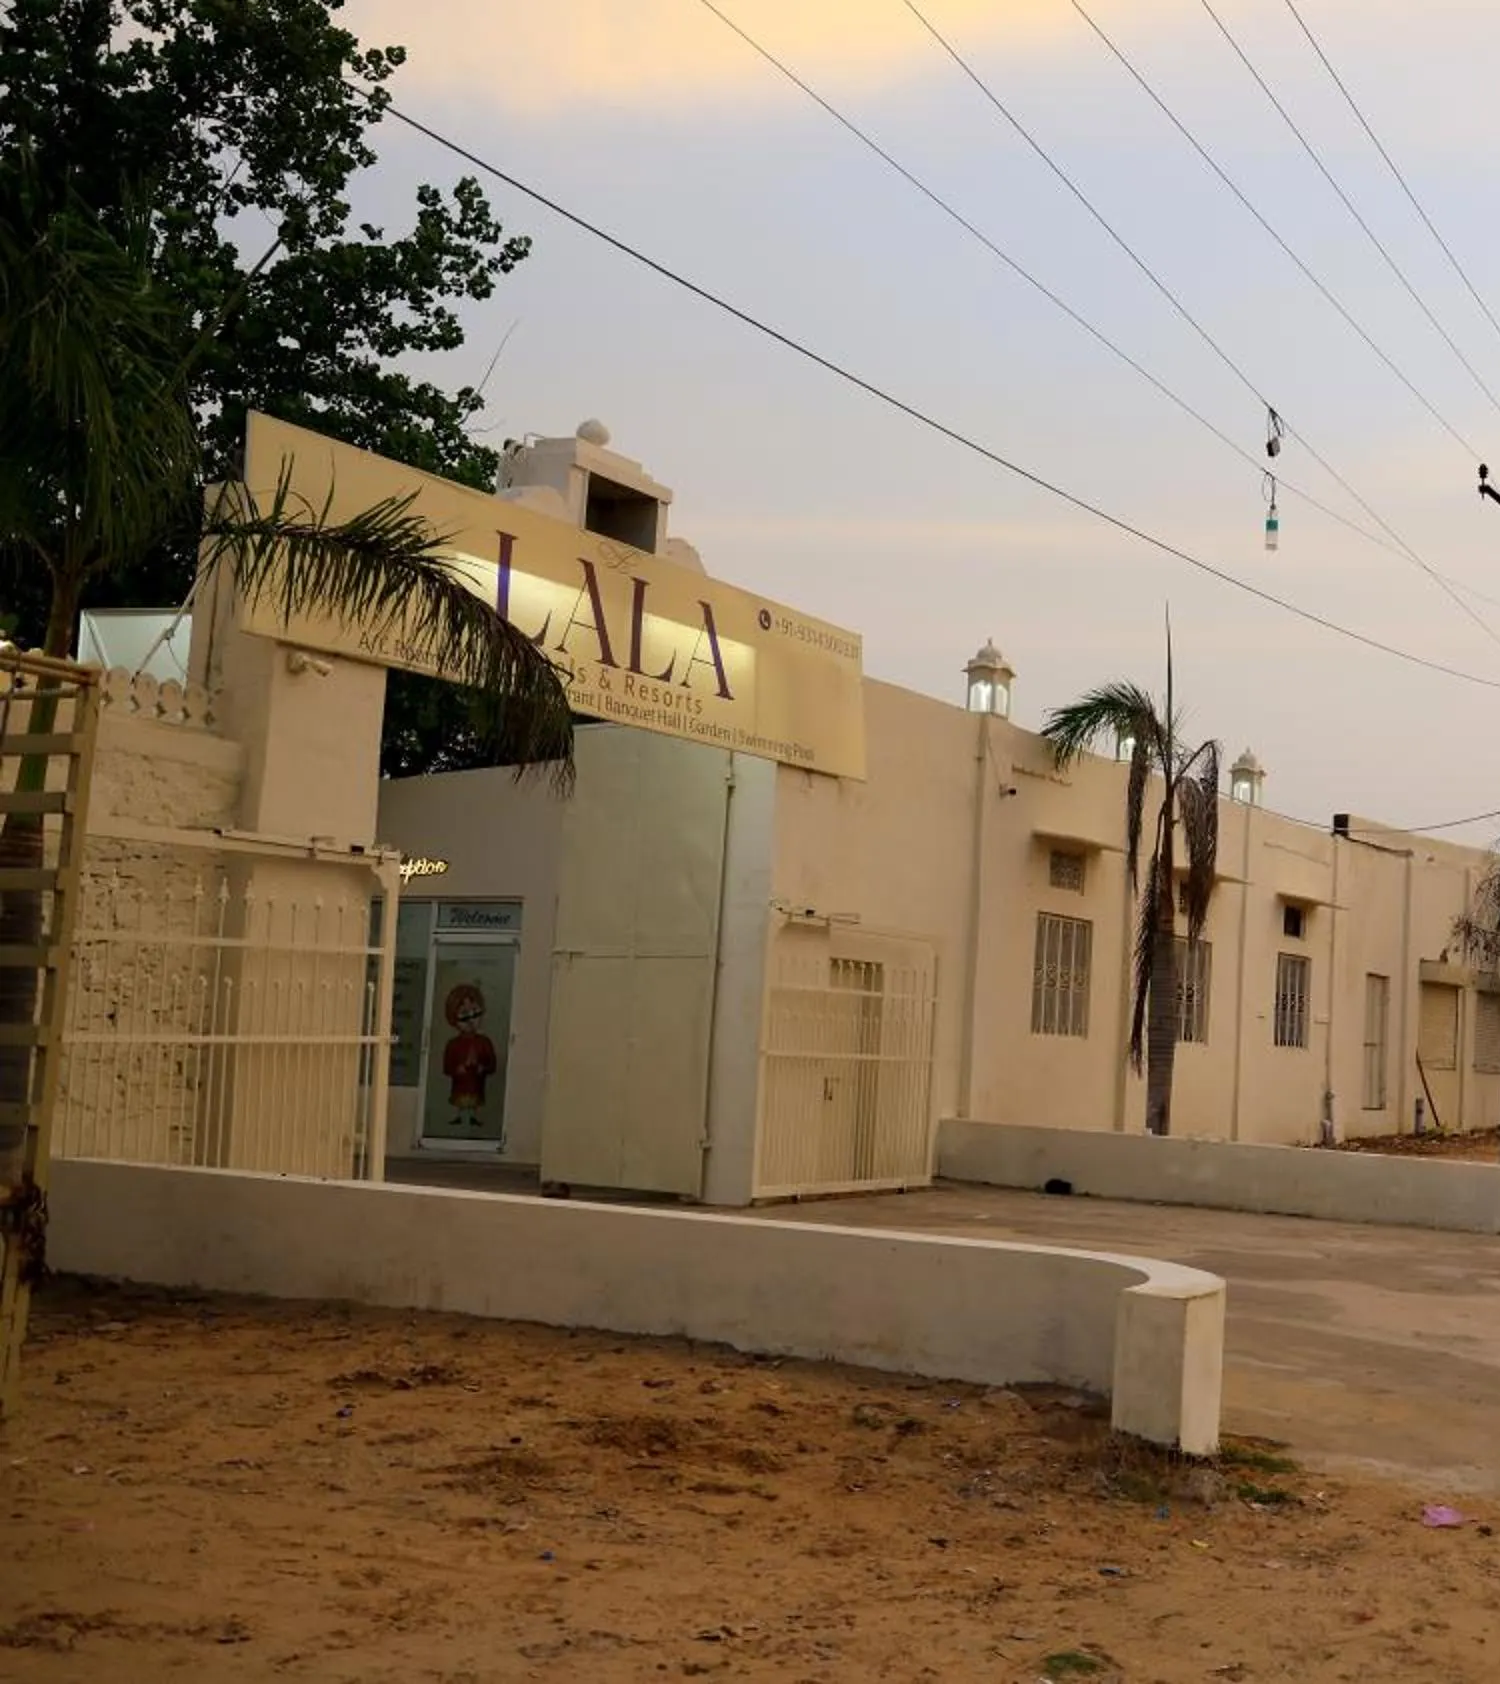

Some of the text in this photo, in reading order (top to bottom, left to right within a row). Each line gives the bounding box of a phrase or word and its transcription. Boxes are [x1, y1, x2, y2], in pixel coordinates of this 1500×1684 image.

[496, 529, 735, 701] LALA
[598, 669, 611, 691] &
[624, 673, 704, 715] Resorts
[605, 693, 655, 723] Banquet
[657, 708, 682, 730] Hall
[689, 716, 731, 741] Garden
